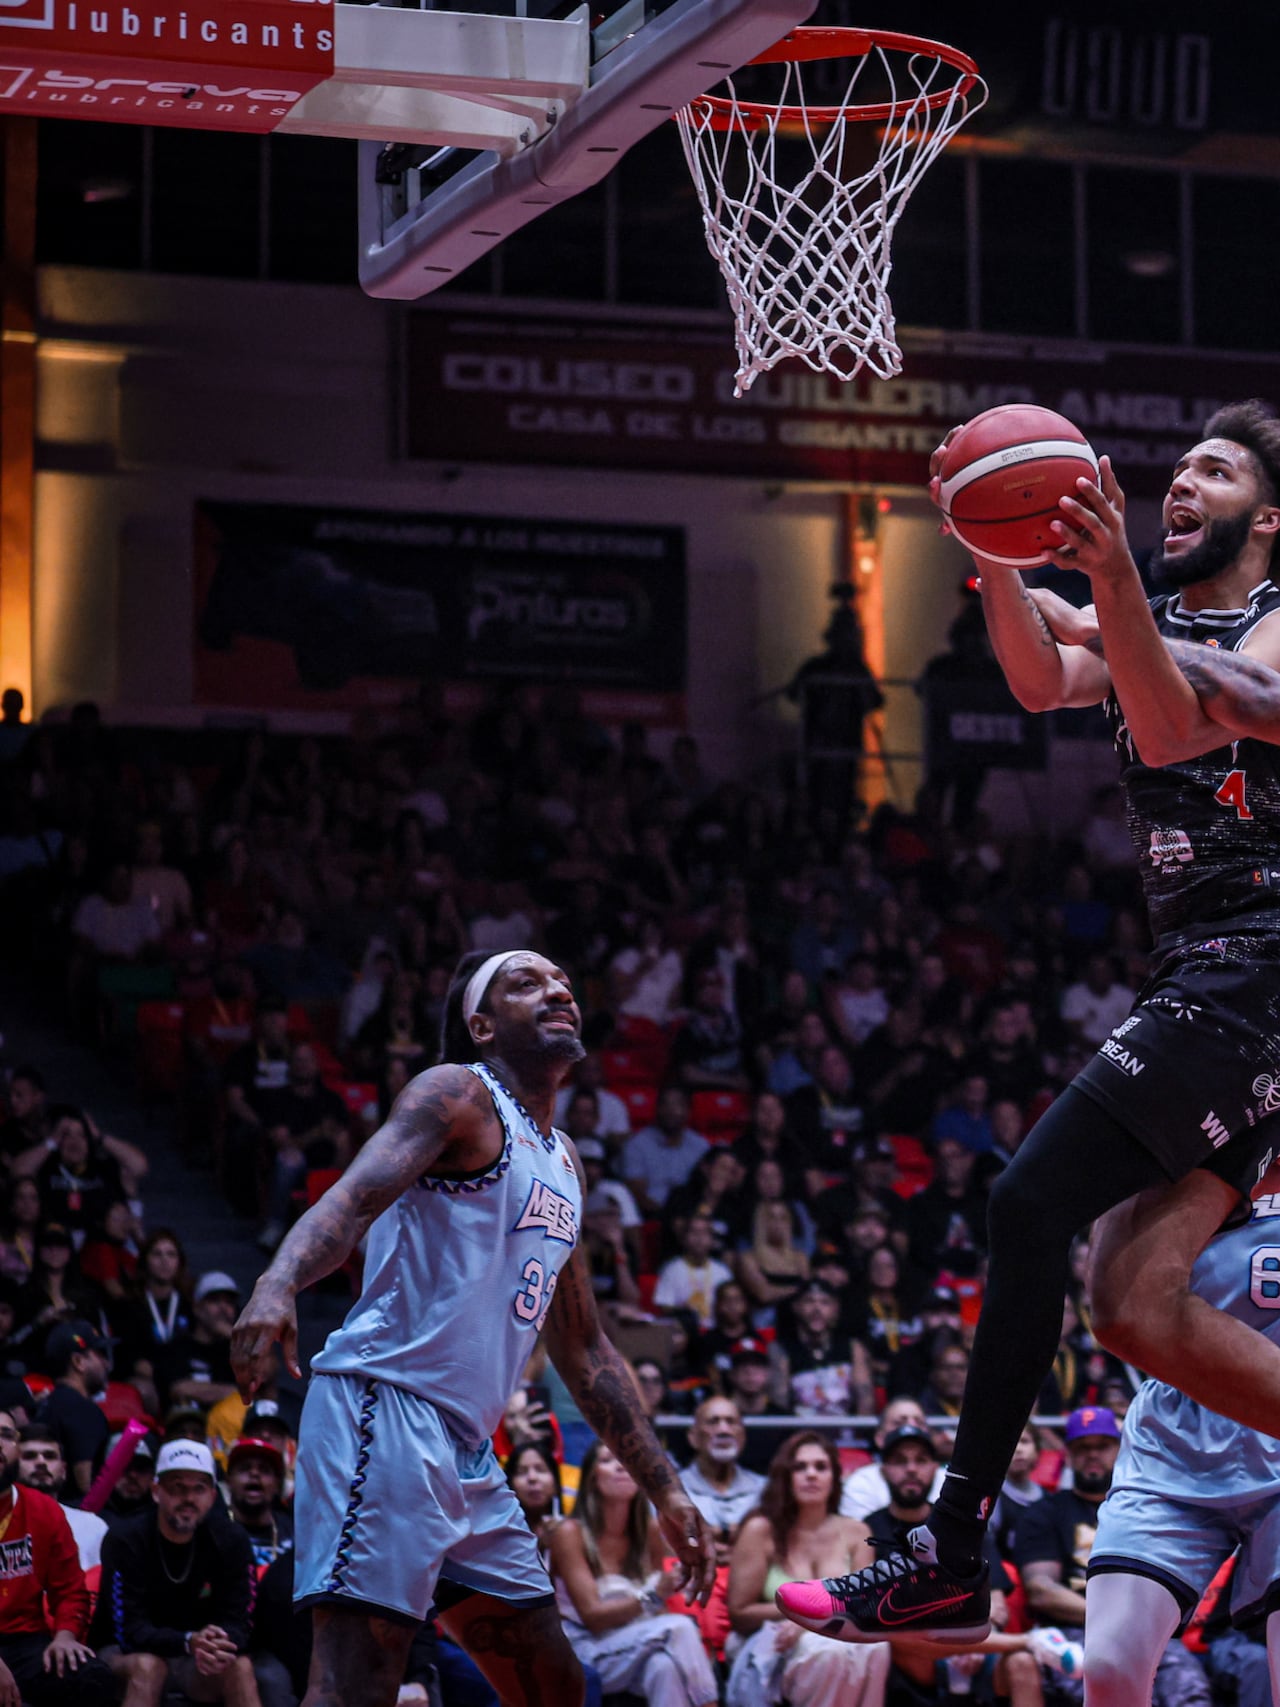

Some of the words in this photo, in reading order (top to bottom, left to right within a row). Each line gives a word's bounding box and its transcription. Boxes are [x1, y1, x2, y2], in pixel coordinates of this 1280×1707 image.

[67, 3, 334, 52] lubricants
[27, 90, 288, 117] lubricants
[37, 69, 302, 102] brava
[441, 353, 697, 402] COLISEO
[1213, 770, 1254, 820] 4
